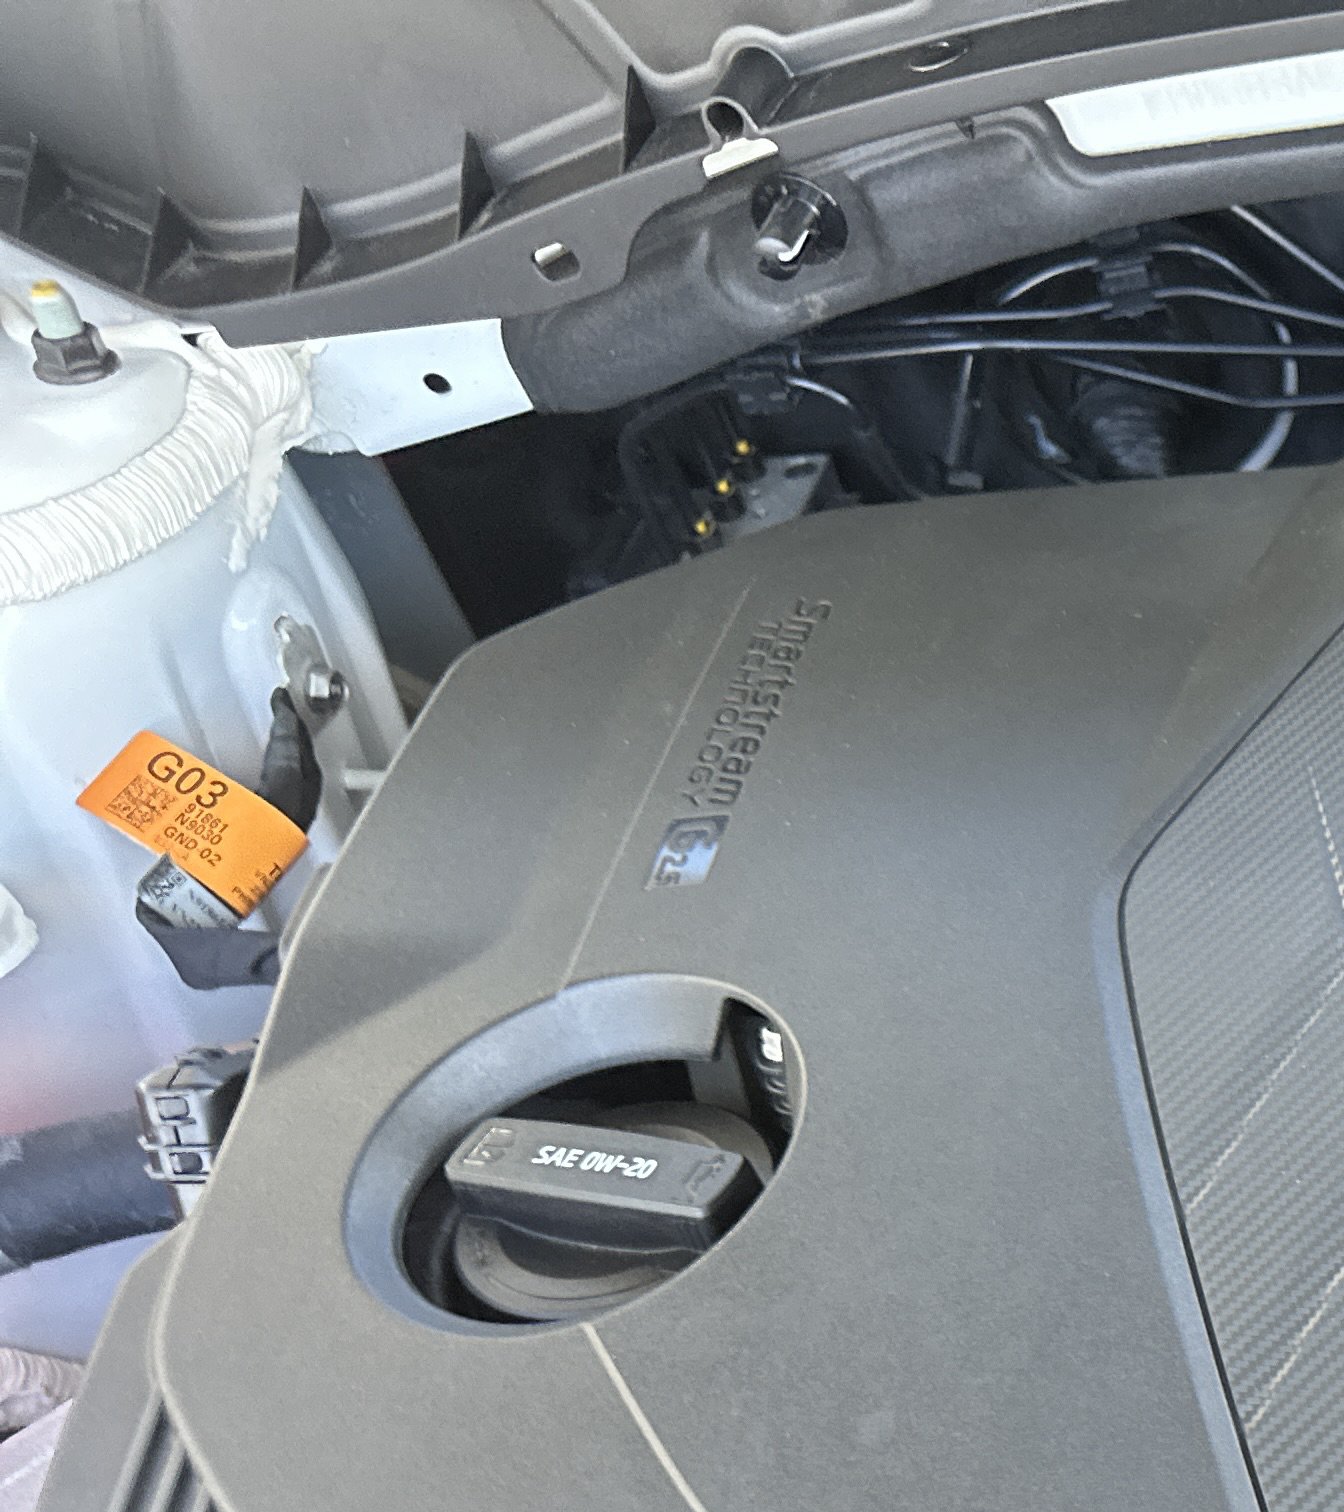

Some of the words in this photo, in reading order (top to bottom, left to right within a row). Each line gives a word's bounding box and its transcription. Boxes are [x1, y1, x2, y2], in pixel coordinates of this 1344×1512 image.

[682, 621, 781, 806] TECHNOLOGY
[709, 596, 833, 805] Smartstream
[148, 751, 229, 809] G03
[532, 1145, 580, 1171] SAE
[582, 1149, 658, 1180] 0W-20
